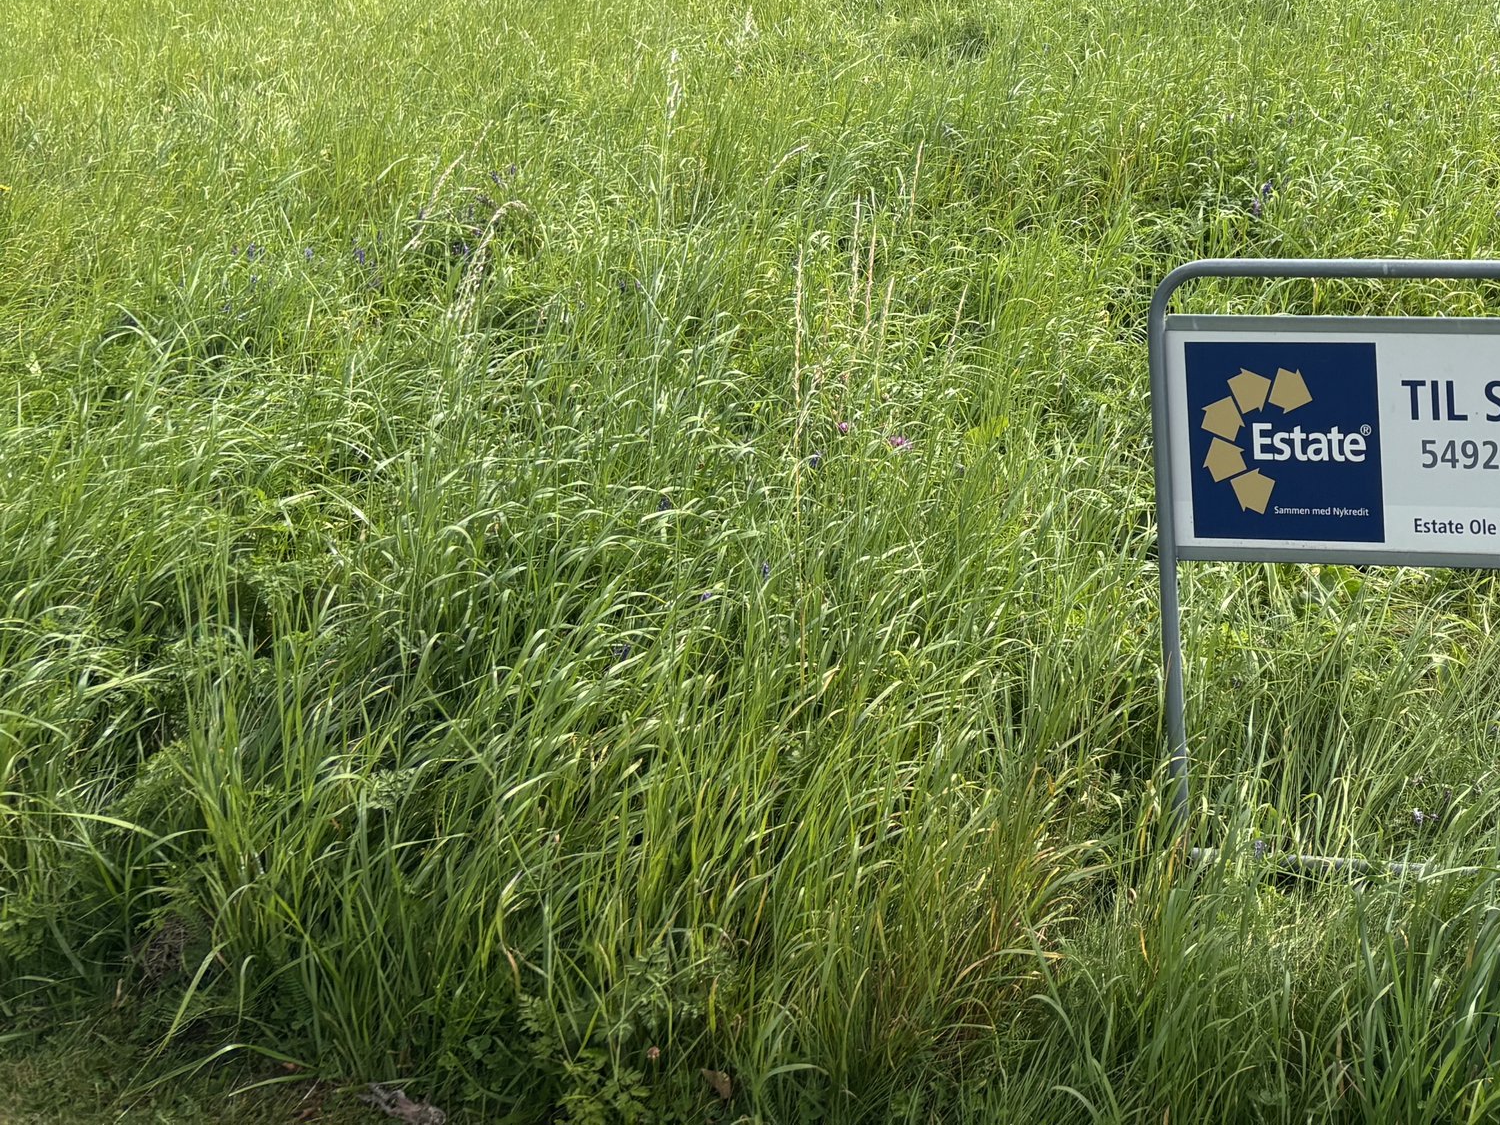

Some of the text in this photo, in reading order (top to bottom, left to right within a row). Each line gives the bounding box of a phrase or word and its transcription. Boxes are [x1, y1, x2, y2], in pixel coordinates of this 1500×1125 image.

[1401, 379, 1469, 421] TIL
[1421, 439, 1500, 470] 5492
[1274, 505, 1370, 518] Sammen med Nykredit
[1413, 517, 1464, 535] Estate
[1469, 519, 1497, 536] Ole
